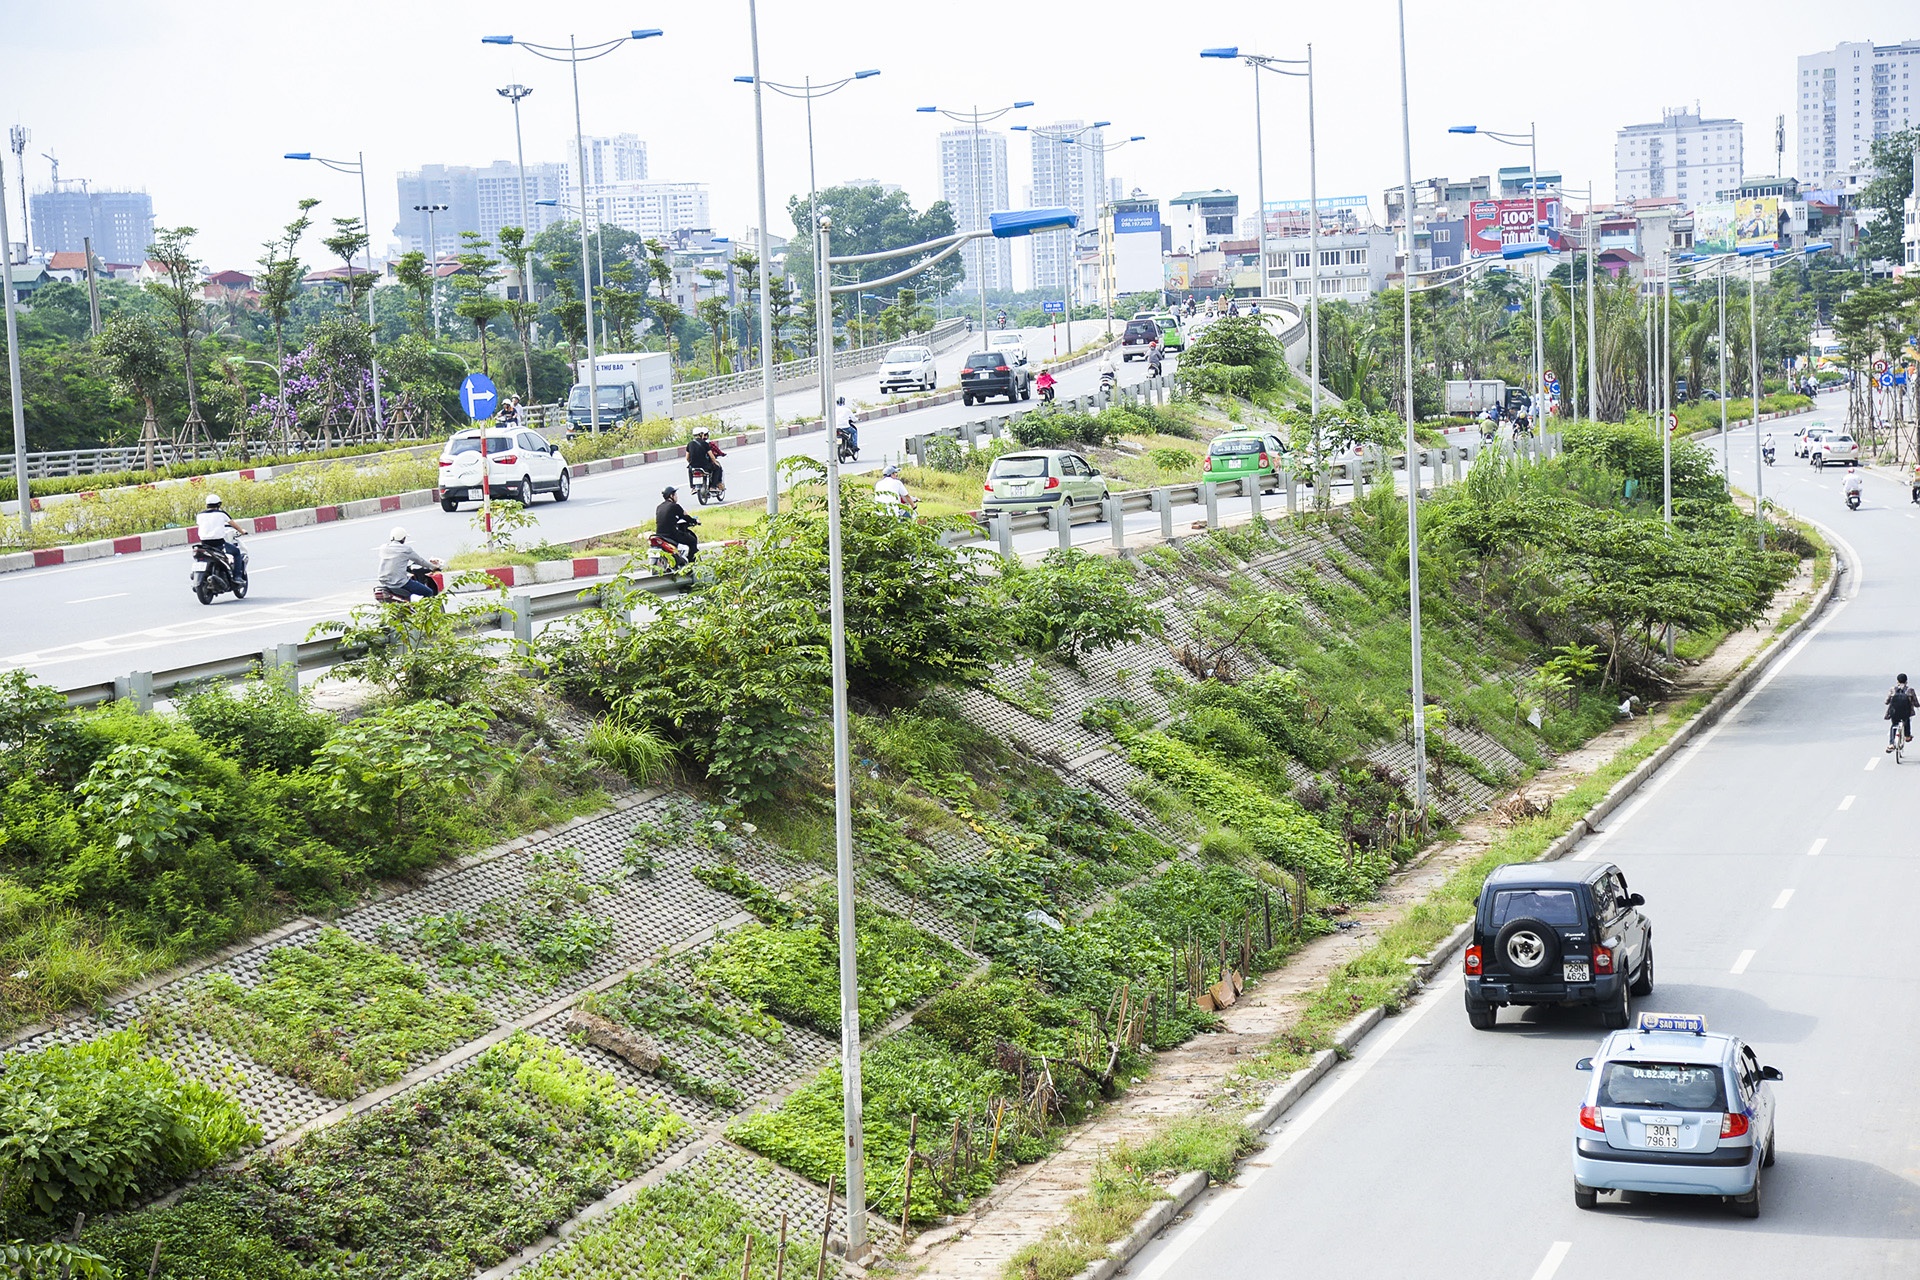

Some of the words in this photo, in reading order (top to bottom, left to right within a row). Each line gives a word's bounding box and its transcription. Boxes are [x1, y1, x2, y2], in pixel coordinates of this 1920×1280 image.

[1568, 964, 1584, 973] 29N
[1566, 972, 1587, 981] 4626
[1659, 1020, 1673, 1029] SAO
[1653, 1125, 1671, 1136] 30A
[1647, 1136, 1678, 1147] 796.13
